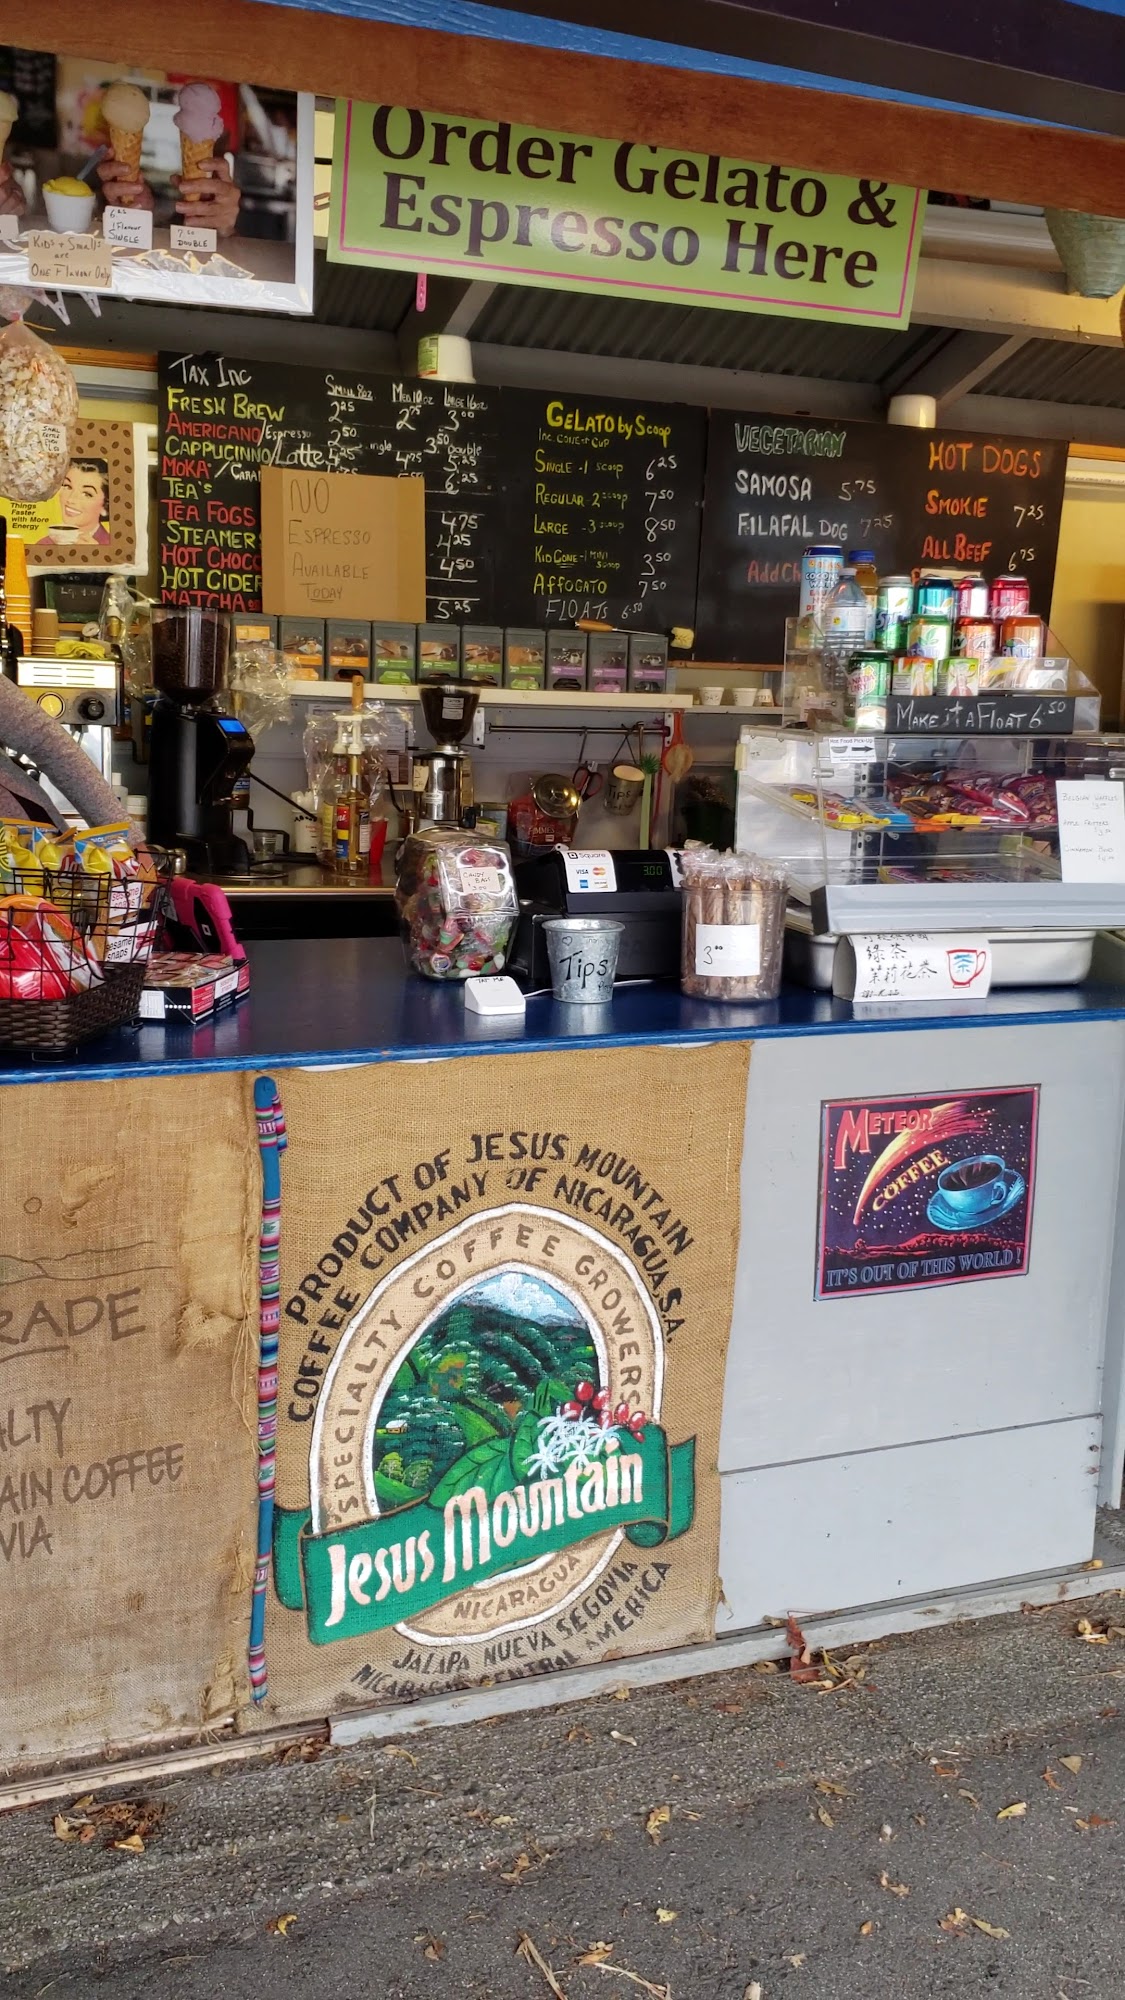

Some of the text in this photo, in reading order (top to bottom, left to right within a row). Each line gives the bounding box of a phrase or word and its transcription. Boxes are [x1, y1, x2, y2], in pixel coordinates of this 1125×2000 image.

[372, 105, 897, 228] Order Gelato &
[108, 229, 139, 243] SINGLE
[178, 240, 208, 248] DOUBLE
[379, 171, 879, 289] Espresso Here
[54, 264, 92, 277] Flavour
[167, 386, 285, 422] FRESH BREW
[617, 416, 633, 440] by
[735, 423, 847, 458] VEGETARIAN
[161, 455, 261, 482] MOKA CARA
[929, 442, 1041, 479] HOT DOGS
[290, 478, 330, 514] NO
[535, 483, 585, 507] REGULAR
[735, 470, 811, 501] SAMOSA
[160, 499, 257, 527] TEA FOGS
[925, 490, 988, 518] SMOKIE
[288, 519, 371, 545] ESPRESSO
[534, 514, 569, 535] LARGE
[737, 513, 814, 538] FILAFAL
[819, 519, 849, 541] DOG
[161, 543, 203, 566] HOT
[921, 534, 992, 563] ALL BEEF
[160, 566, 205, 589] HOT
[292, 552, 369, 580] AVAILABLE
[161, 589, 246, 613] MATCHA
[301, 582, 344, 602] TODAY
[560, 950, 609, 989] Tips
[833, 1108, 934, 1170] METEOR
[872, 1149, 952, 1211] COFFEE
[285, 1131, 696, 1326] PRODUCT OF JESUS MOUNTAIN
[826, 1257, 956, 1287] IT'S OUT OF THIS
[288, 1286, 361, 1422] COFFEE
[360, 1169, 490, 1270] COMPANY
[506, 1167, 548, 1192] OF
[333, 1224, 642, 1513] SPECIALTY COFFEE GROWERS
[63, 1443, 184, 1504] COFFEE
[325, 1440, 643, 1627] Jesus Mountain
[453, 1554, 581, 1621] NICARAGUA
[392, 1560, 639, 1674] JALAPA NUEVA SEGOVIA
[585, 1561, 673, 1652] AMERICA
